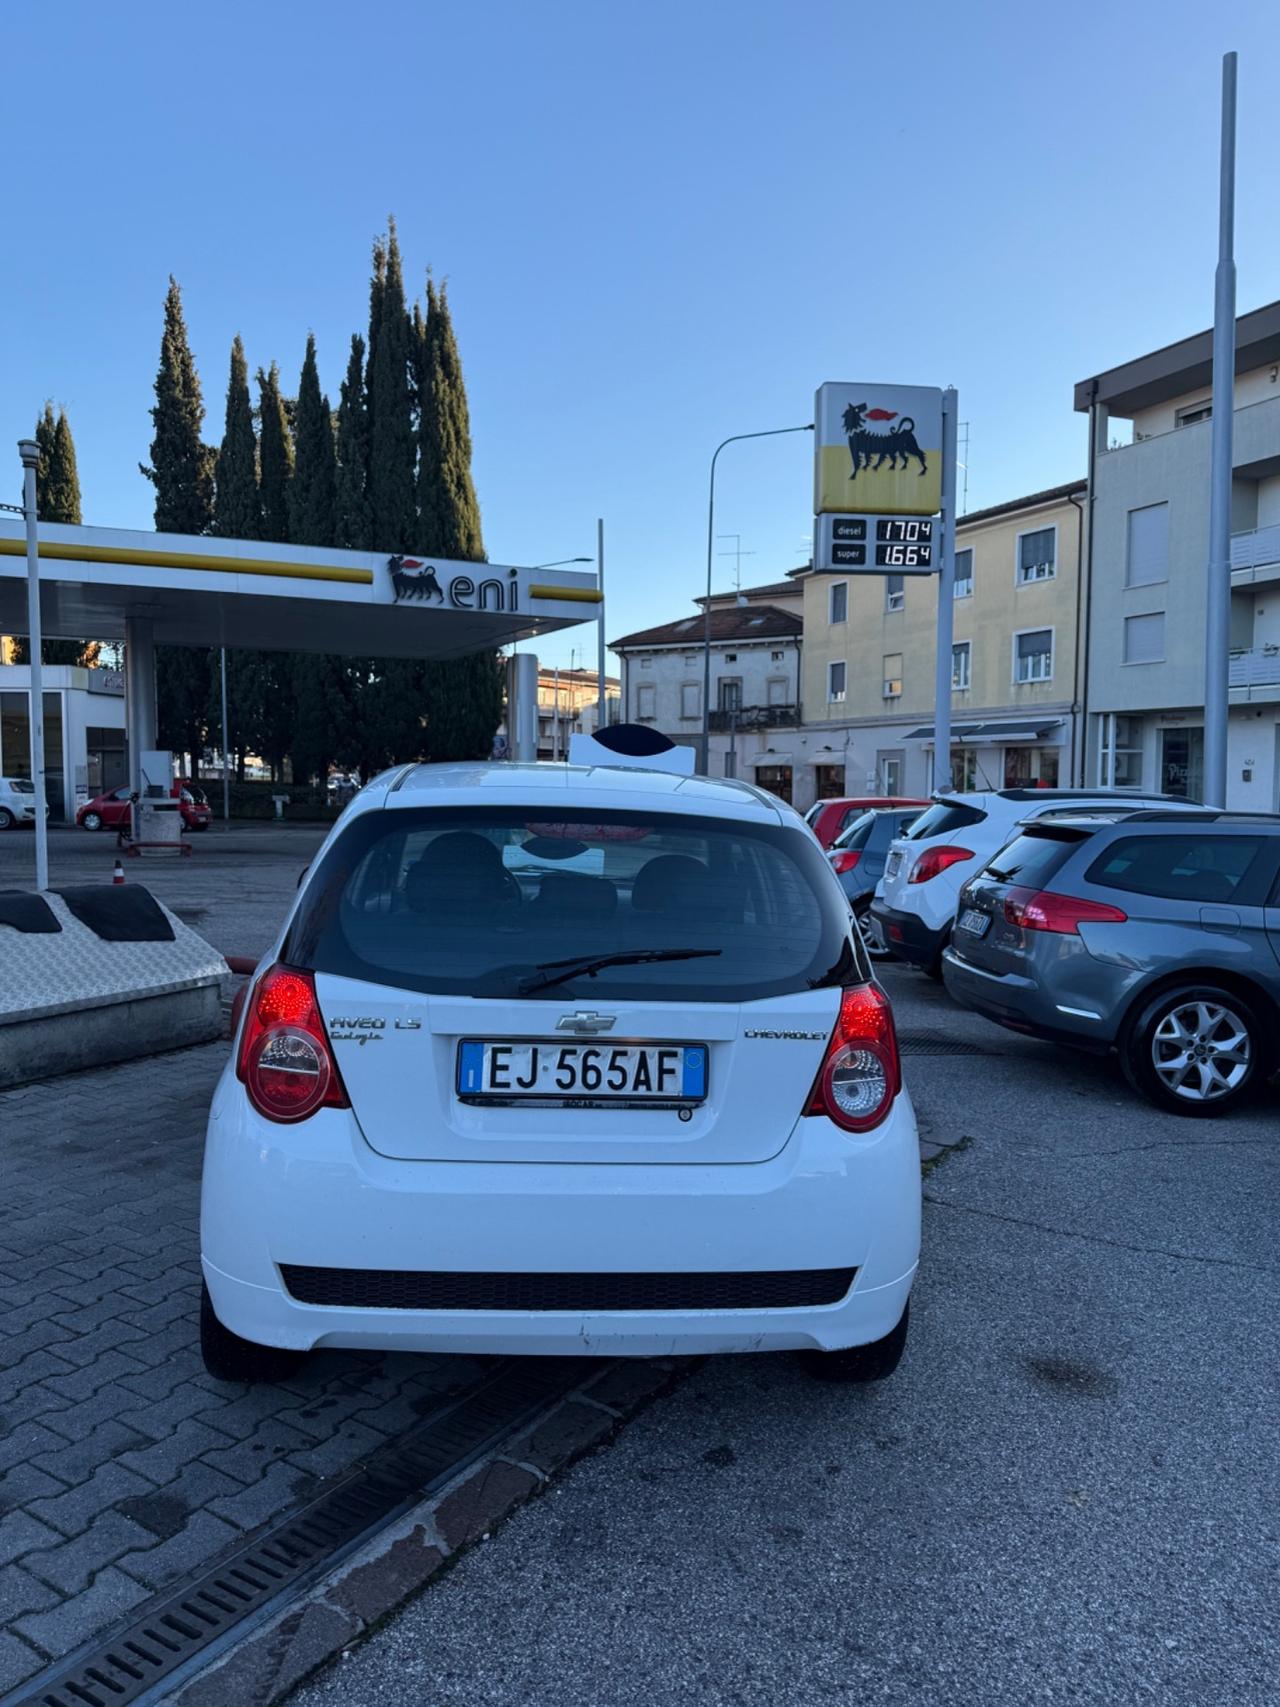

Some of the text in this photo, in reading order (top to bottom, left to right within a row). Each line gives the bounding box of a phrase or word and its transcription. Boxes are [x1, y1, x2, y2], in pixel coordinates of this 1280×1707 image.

[837, 527, 861, 535] diesel
[837, 551, 859, 559] super
[450, 568, 519, 612] eni
[329, 1017, 421, 1030] AVEO LS
[744, 1029, 828, 1041] CHEVROLET
[489, 1046, 679, 1092] EJ 565AF
